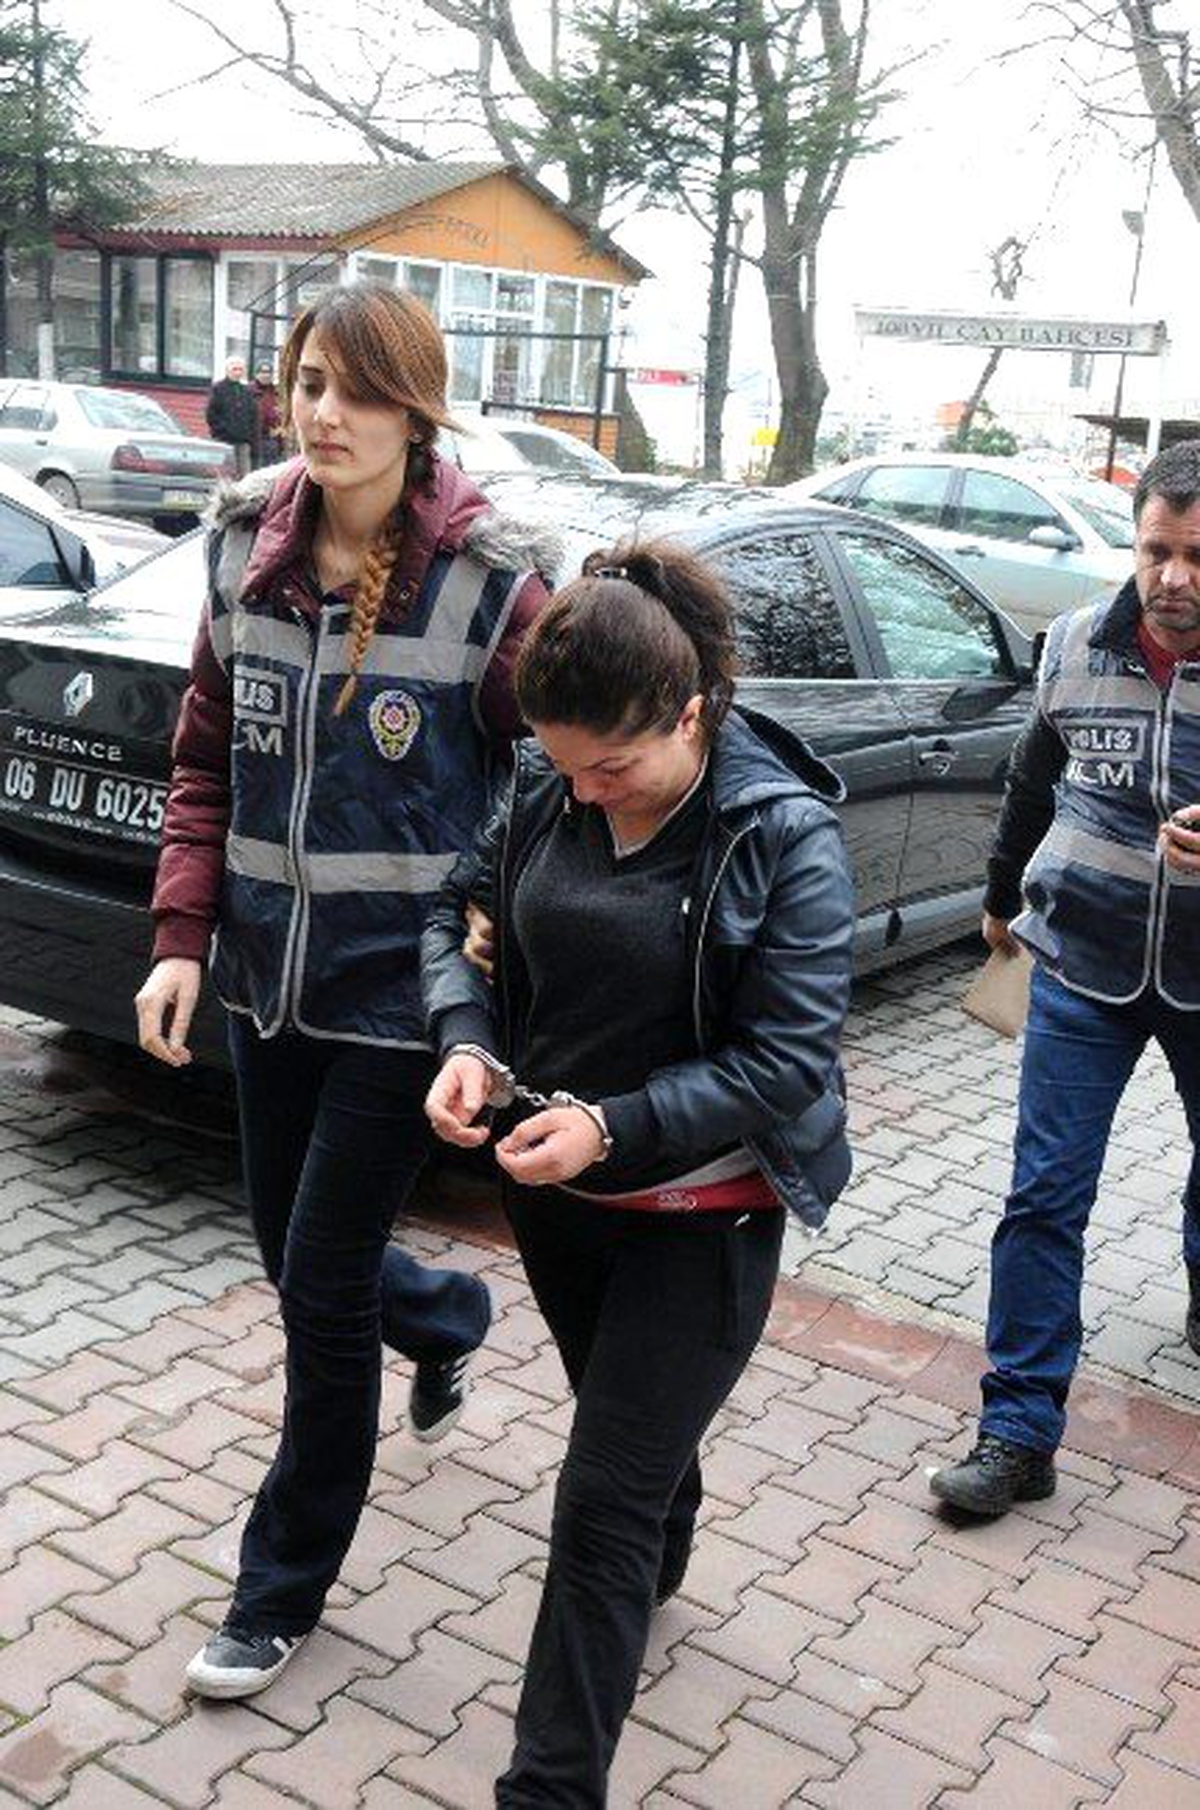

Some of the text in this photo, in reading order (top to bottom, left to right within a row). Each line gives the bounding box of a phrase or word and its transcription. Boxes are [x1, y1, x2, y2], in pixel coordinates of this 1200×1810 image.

[4, 757, 37, 801] 06
[49, 767, 87, 812] DU
[95, 777, 167, 831] 6025
